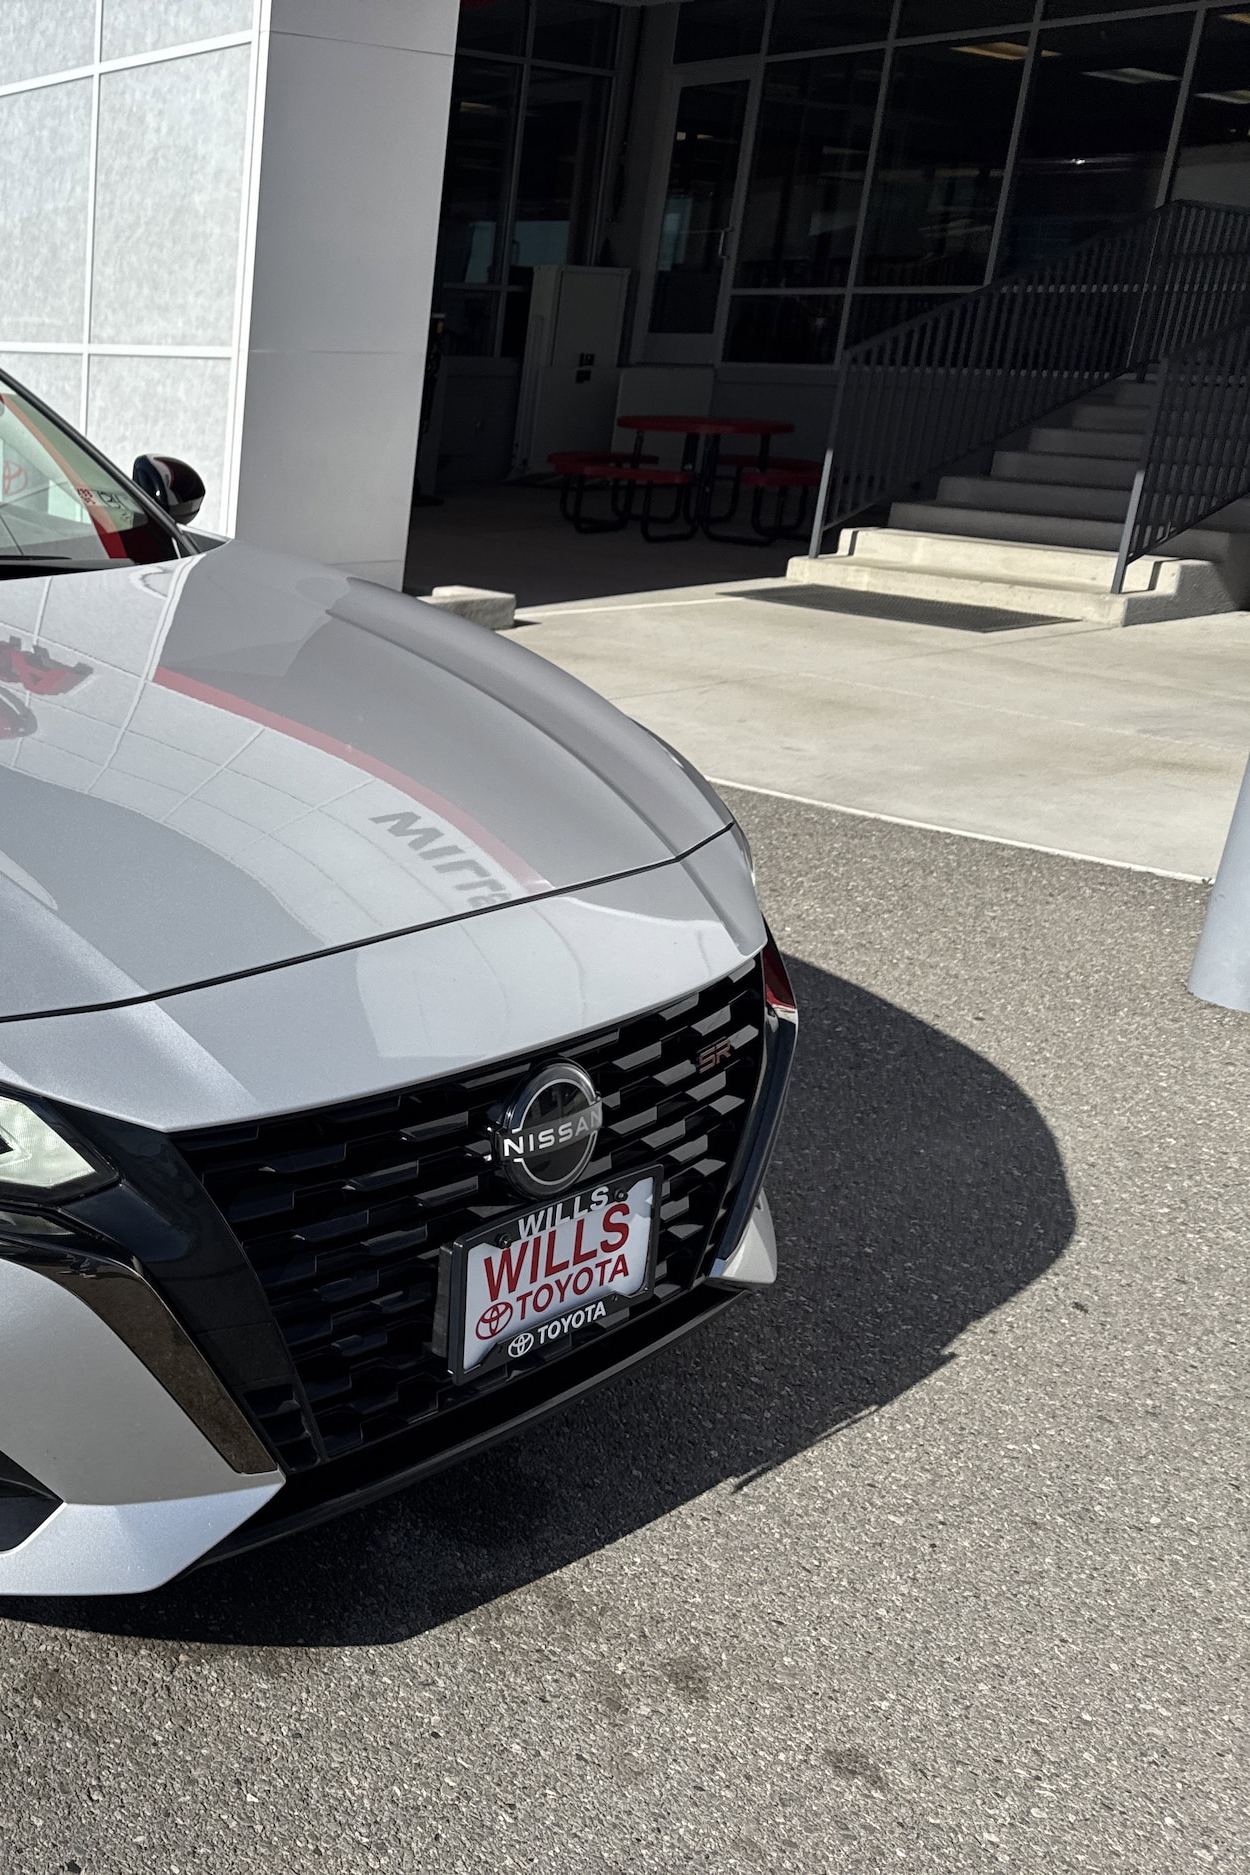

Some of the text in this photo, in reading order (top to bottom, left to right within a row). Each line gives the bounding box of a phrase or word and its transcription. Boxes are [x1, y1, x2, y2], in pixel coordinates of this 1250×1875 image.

[699, 1039, 731, 1073] SR
[503, 1109, 602, 1157] NISSAN
[518, 1186, 609, 1240] WILLS
[484, 1203, 630, 1303] WILLS
[516, 1254, 629, 1320] TOYOTA
[538, 1301, 606, 1344] TOYOTA
